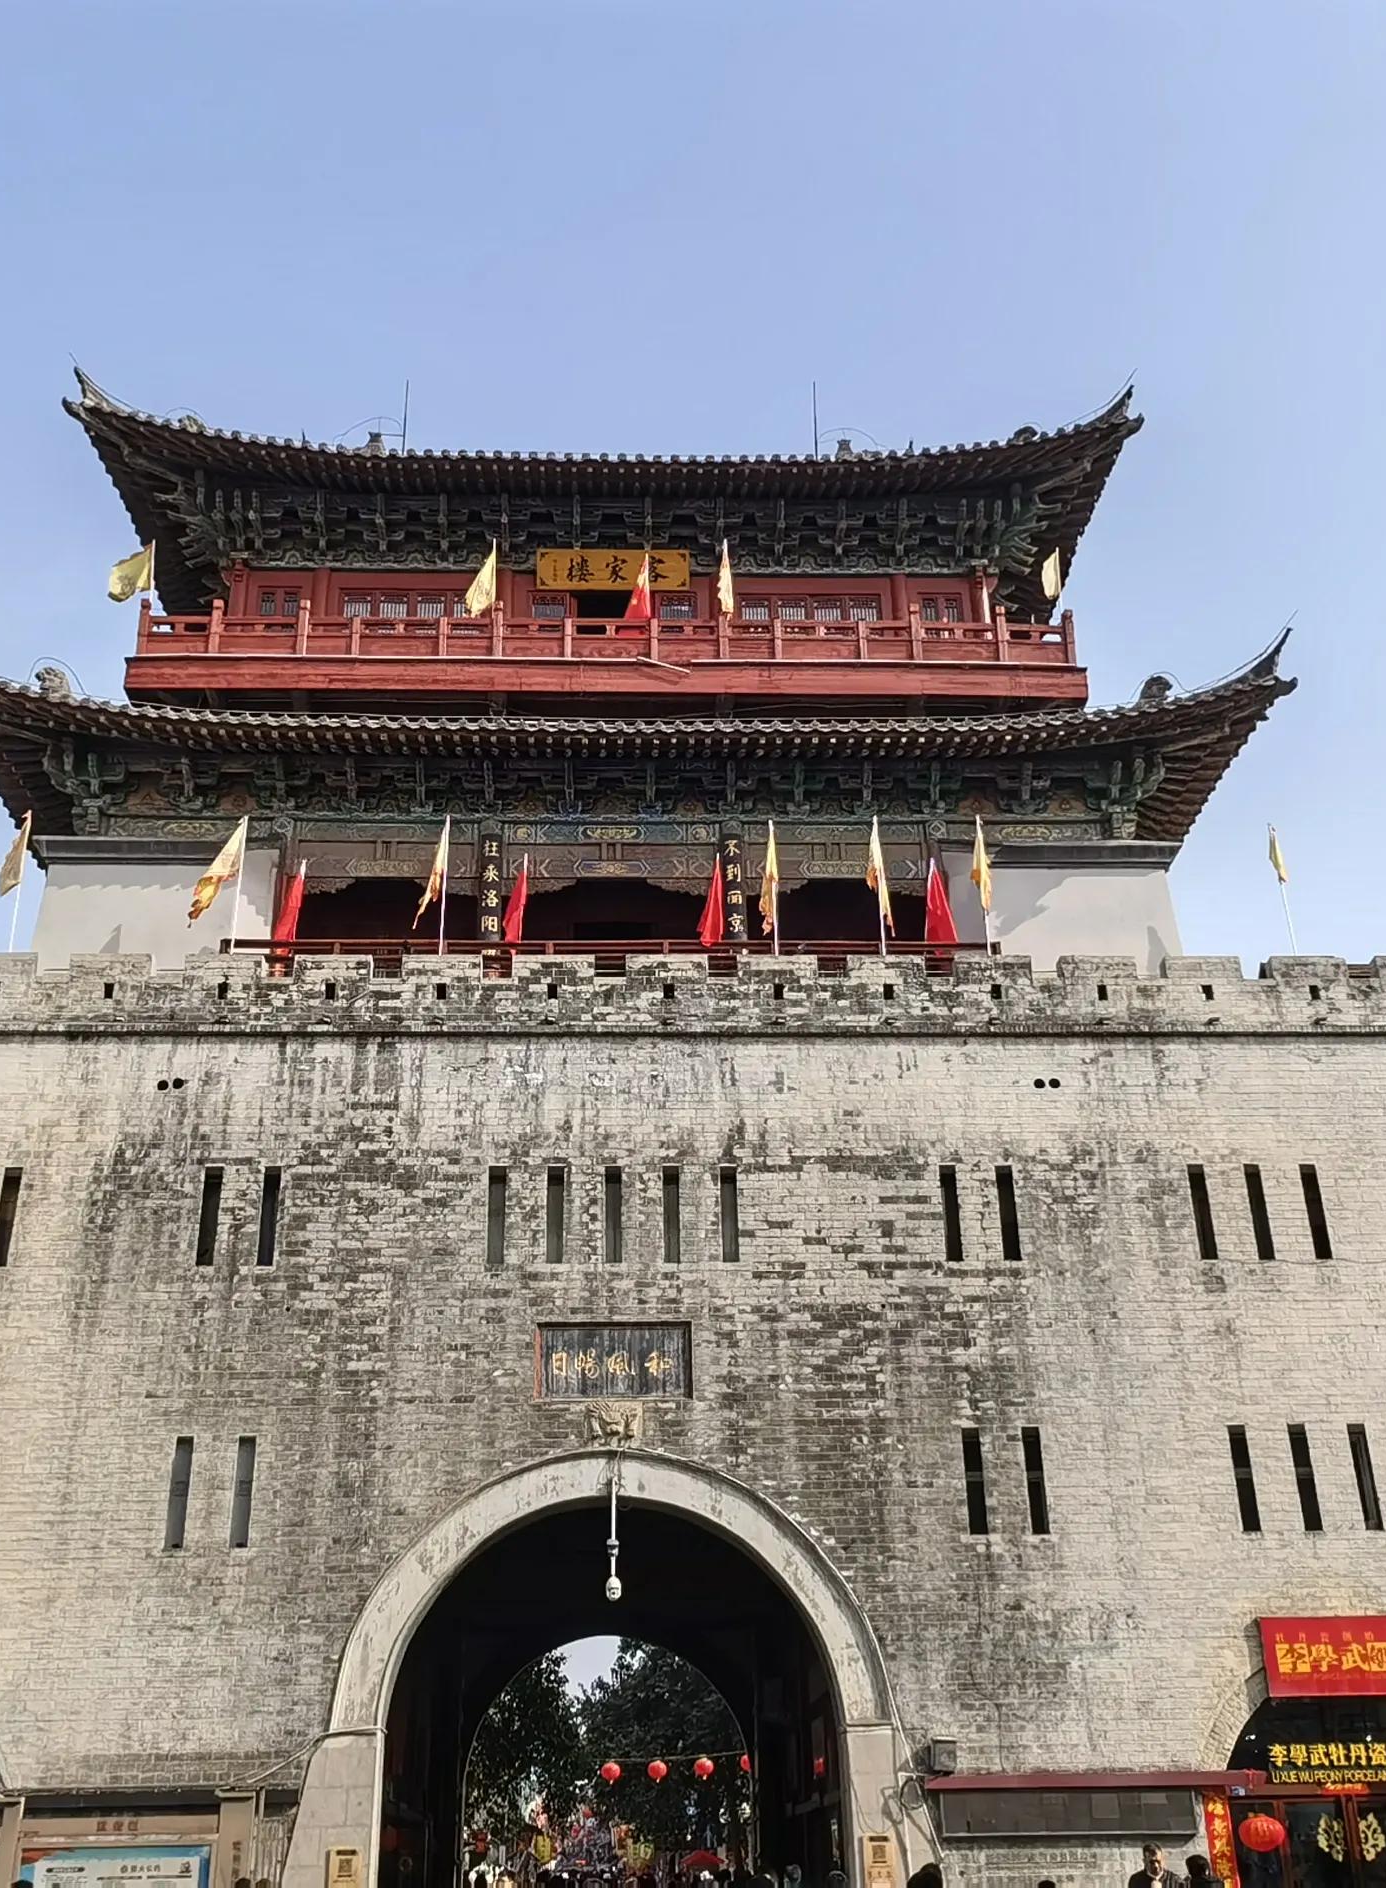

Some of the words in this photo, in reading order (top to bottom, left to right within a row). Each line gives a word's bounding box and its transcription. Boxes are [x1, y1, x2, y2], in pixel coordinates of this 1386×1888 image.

[1280, 1771, 1299, 1783] XUE
[1299, 1771, 1314, 1783] WU
[1315, 1770, 1343, 1783] PEONY
